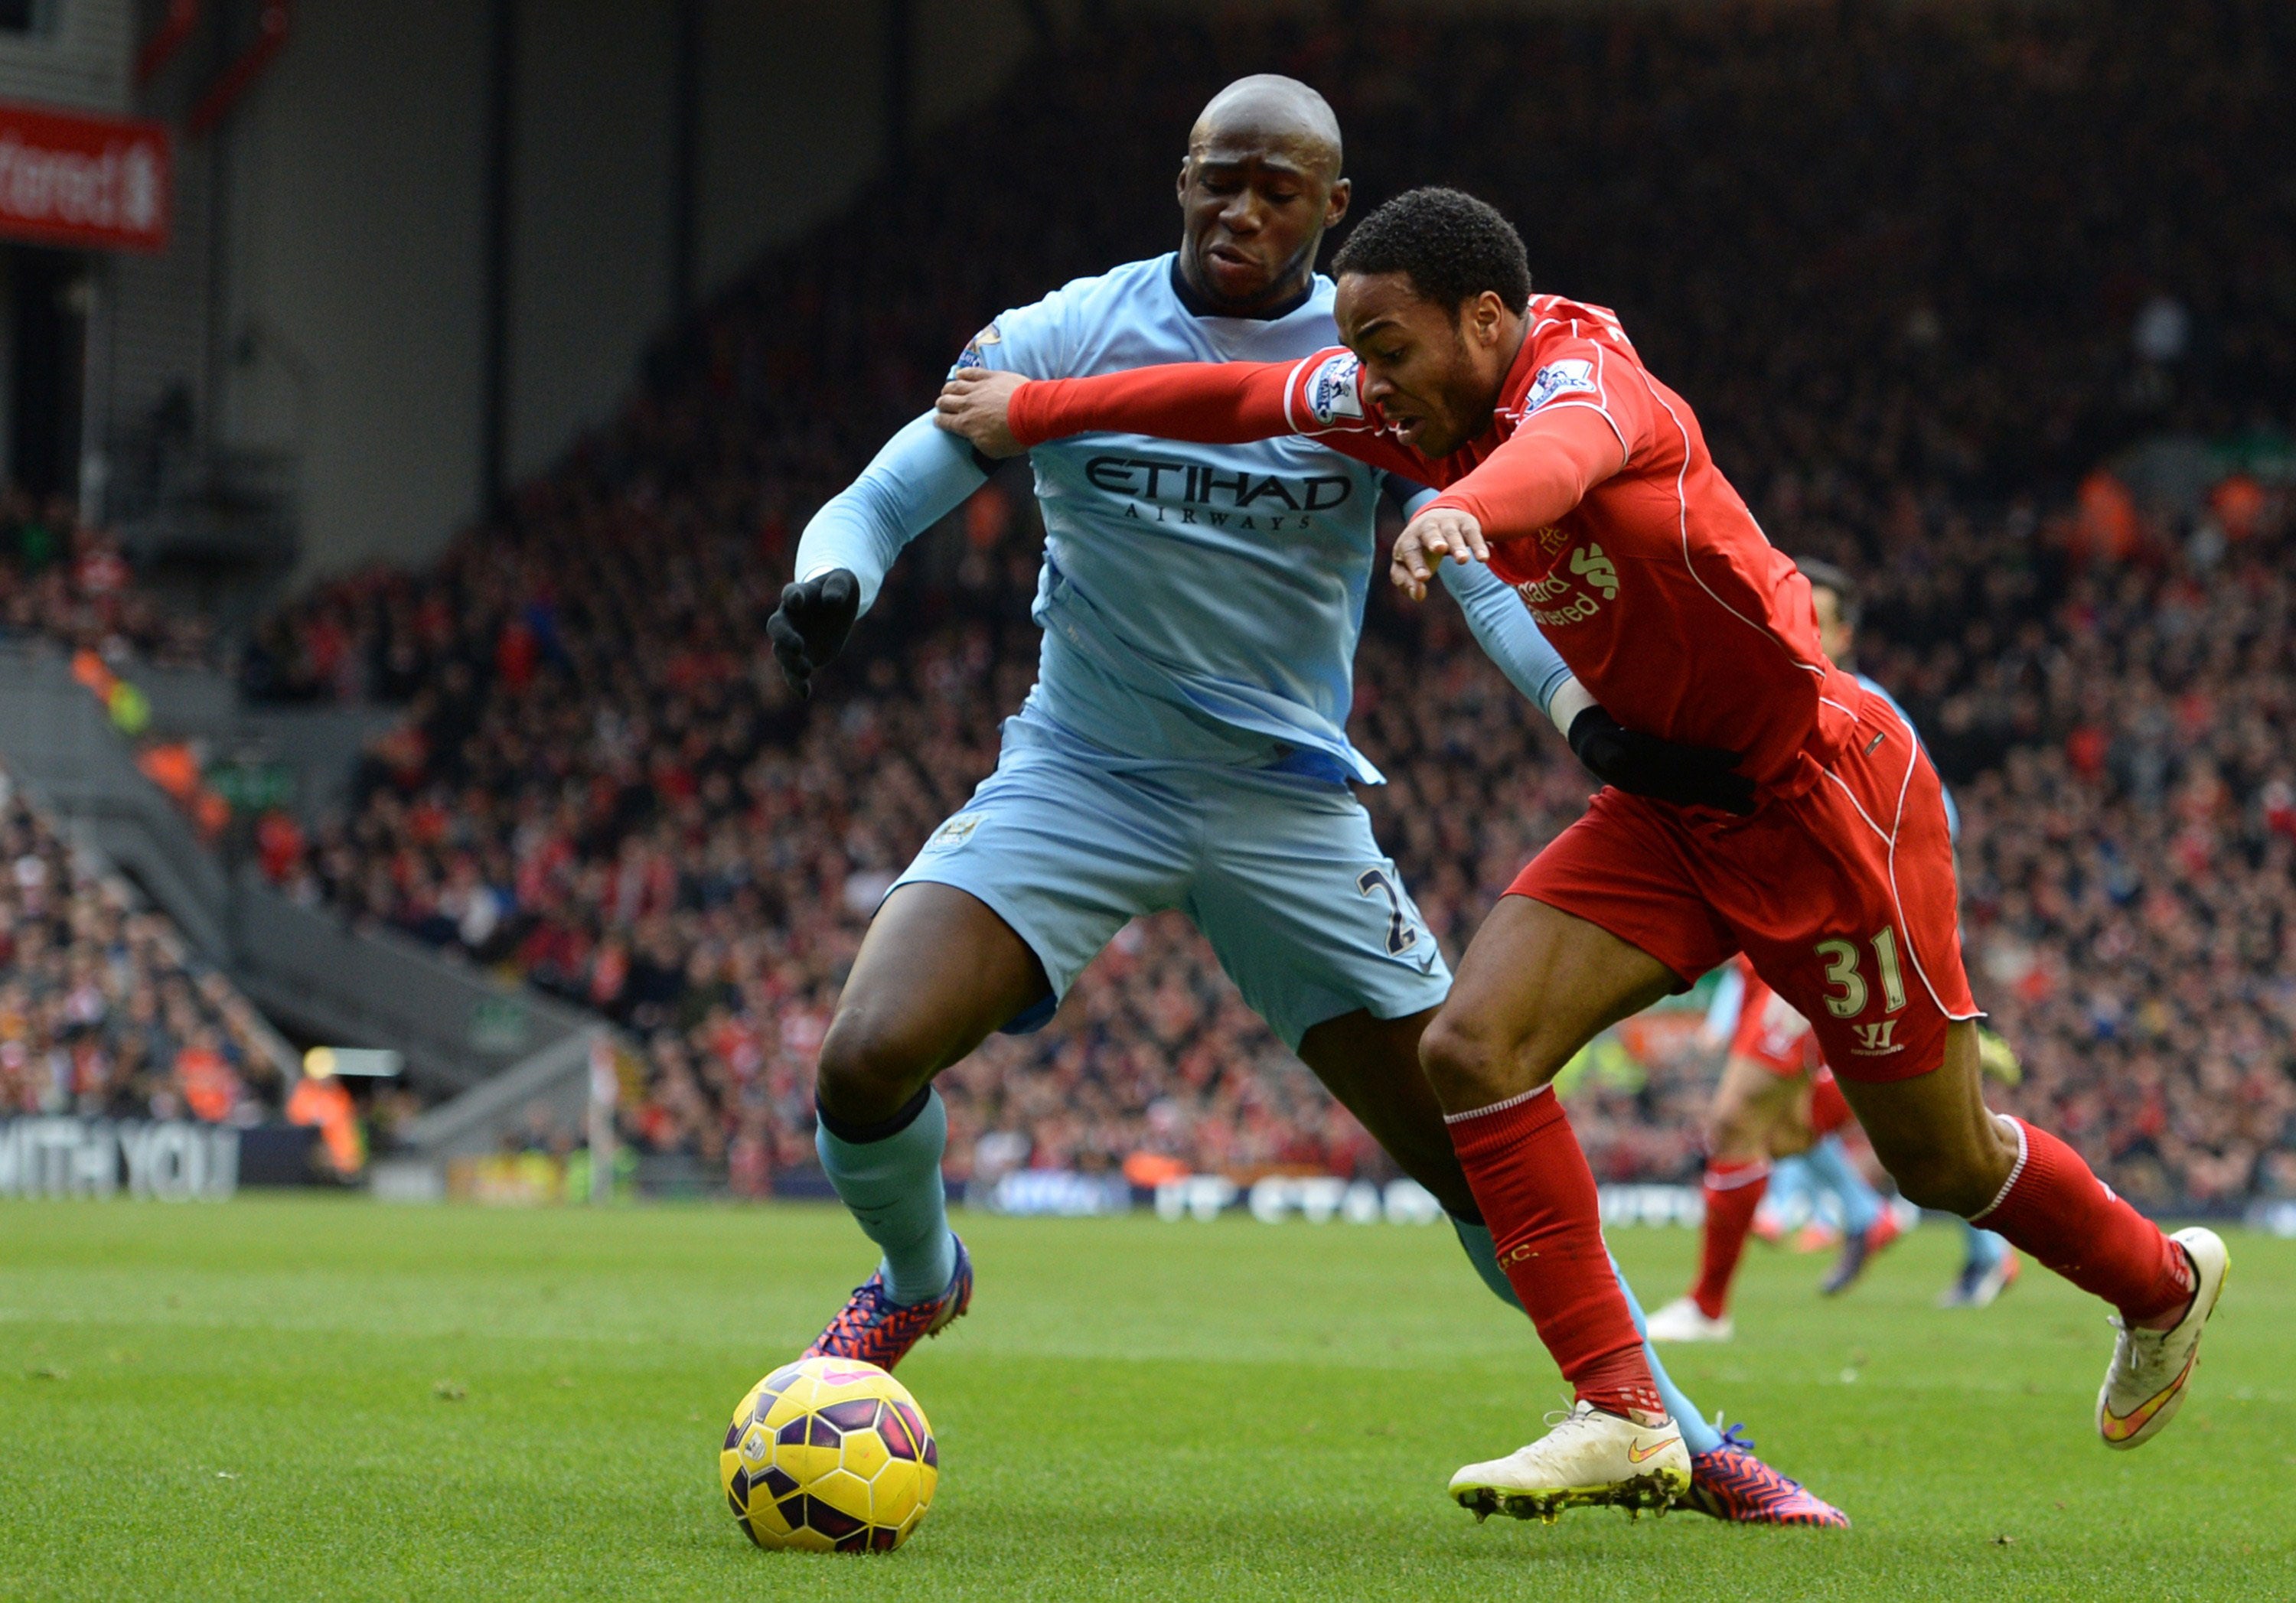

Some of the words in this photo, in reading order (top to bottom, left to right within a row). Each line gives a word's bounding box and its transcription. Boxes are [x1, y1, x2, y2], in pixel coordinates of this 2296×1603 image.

[1085, 456, 1352, 511] ETIHAD
[1124, 503, 1310, 530] AIRWAYS
[1814, 924, 1907, 1019] 31
[116, 1117, 241, 1204] YOU
